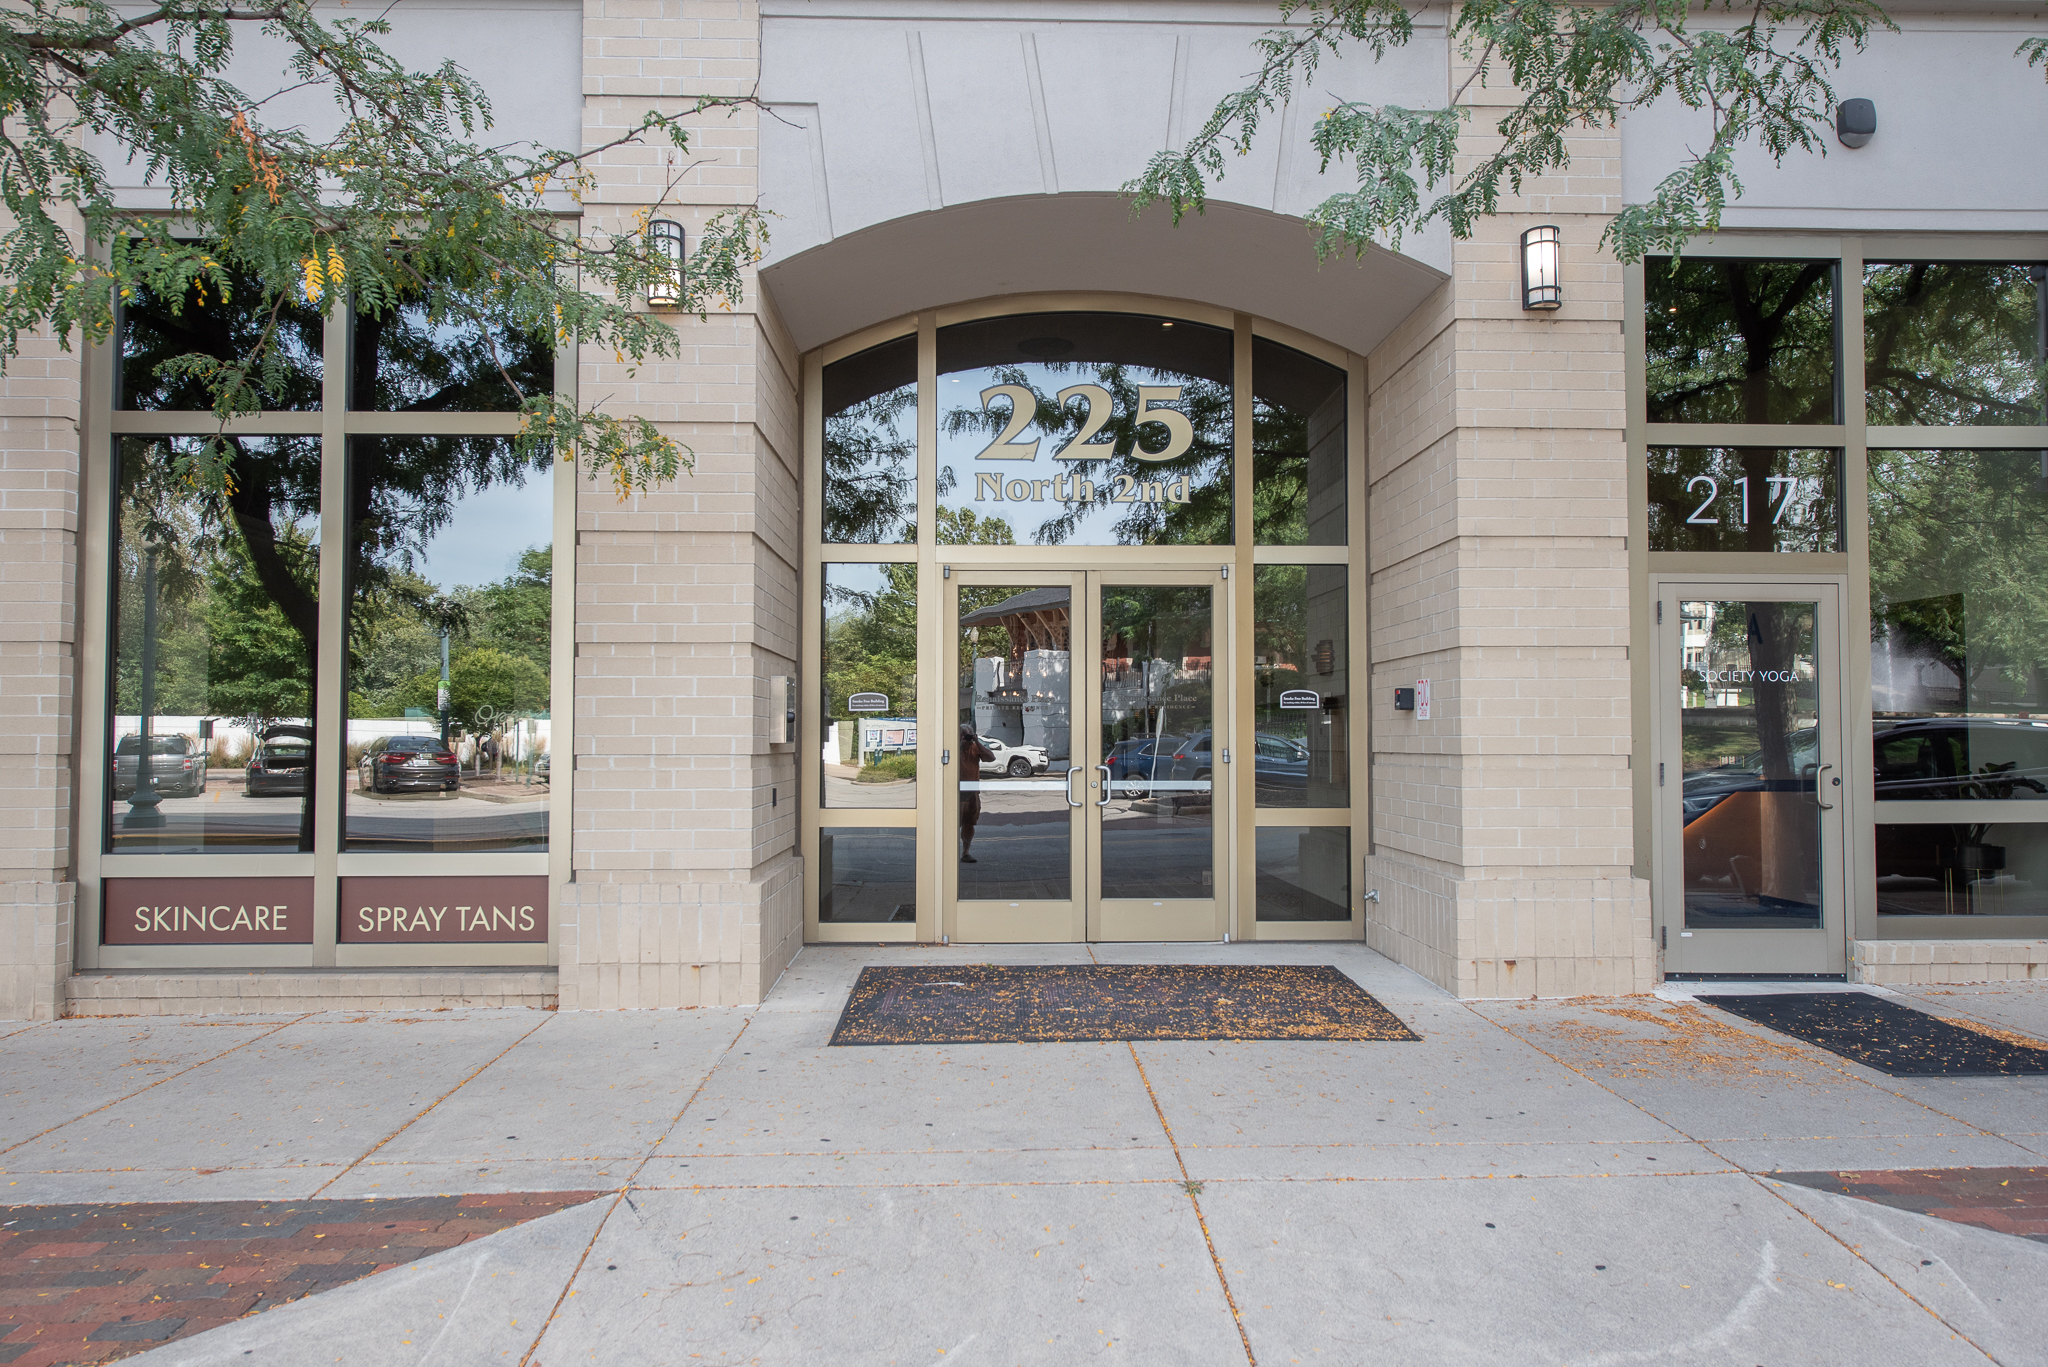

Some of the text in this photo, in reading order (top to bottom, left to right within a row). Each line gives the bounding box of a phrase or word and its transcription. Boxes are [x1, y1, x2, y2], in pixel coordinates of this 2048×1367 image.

[975, 383, 1194, 462] 225
[975, 473, 1191, 503] North 2nd
[1686, 476, 1798, 524] 217
[1699, 670, 1800, 683] SOCIETY YOGA
[1174, 694, 1198, 702] Place
[1417, 679, 1429, 707] FDC
[134, 905, 288, 932] SKINCARE
[358, 905, 535, 932] SPRAY TANS
